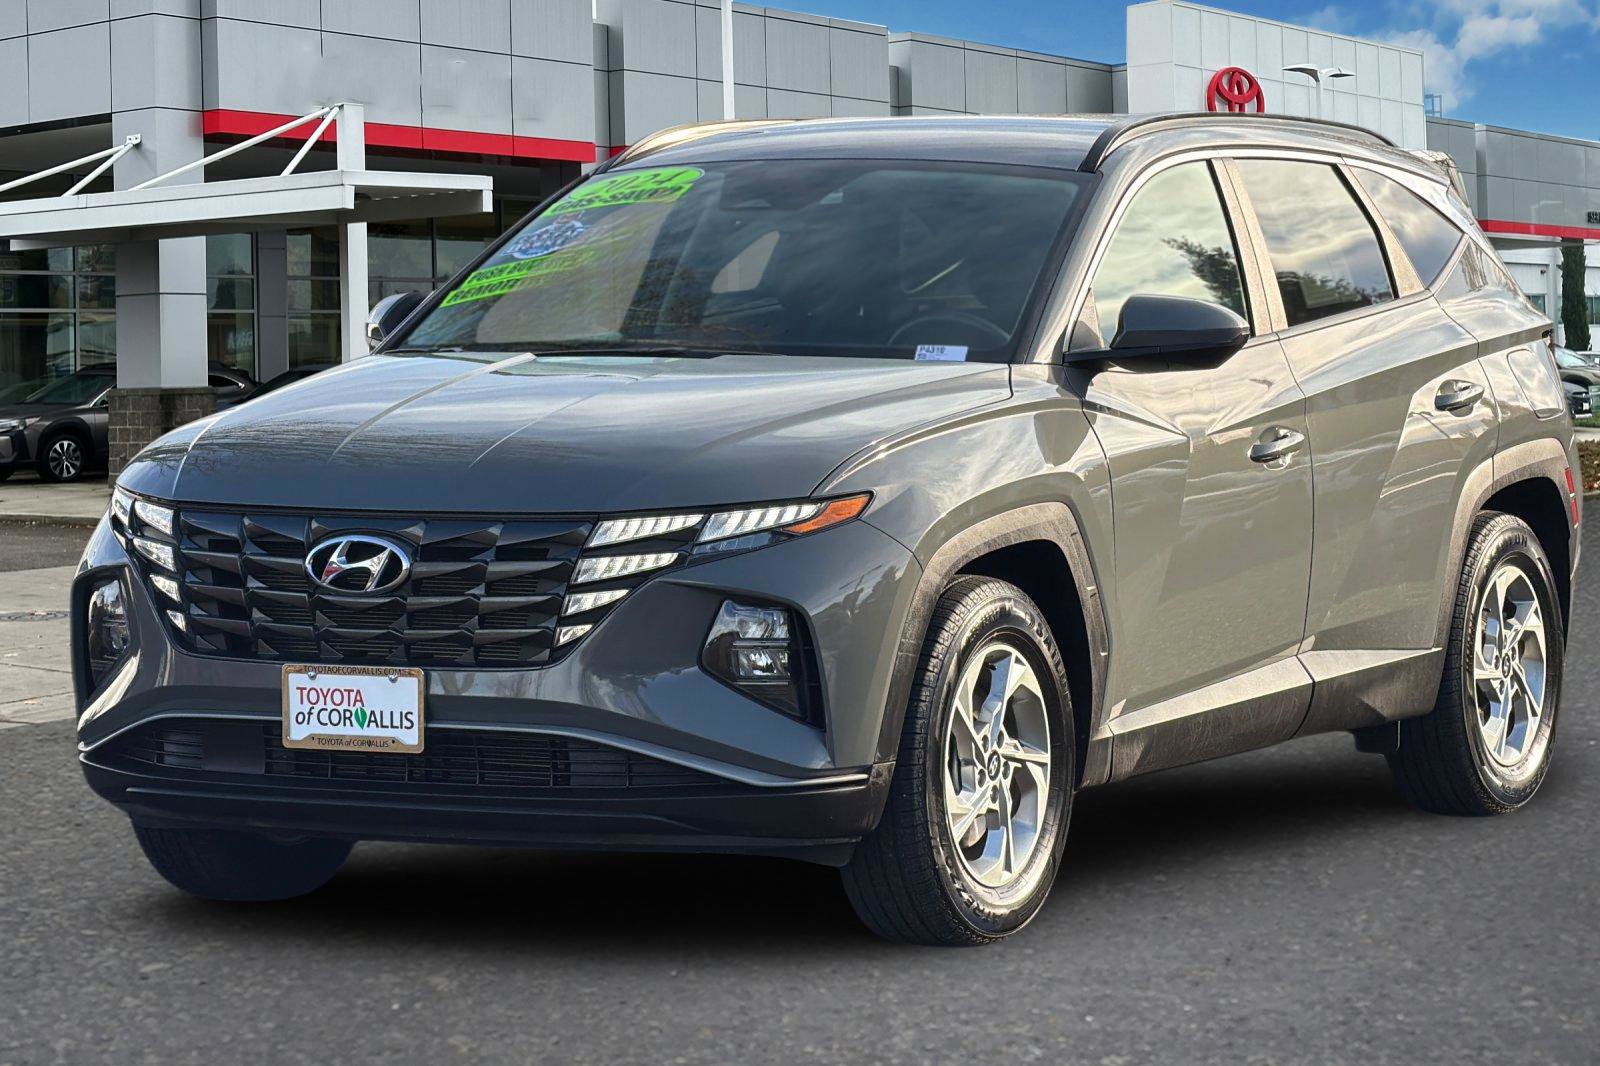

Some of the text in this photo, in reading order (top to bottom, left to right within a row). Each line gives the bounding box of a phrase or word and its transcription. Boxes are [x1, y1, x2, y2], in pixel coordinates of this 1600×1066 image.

[296, 686, 365, 707] TOYOTA
[295, 706, 415, 730] of CORVALLIS
[316, 738, 389, 748] TOYOTA of CORVALLIS
